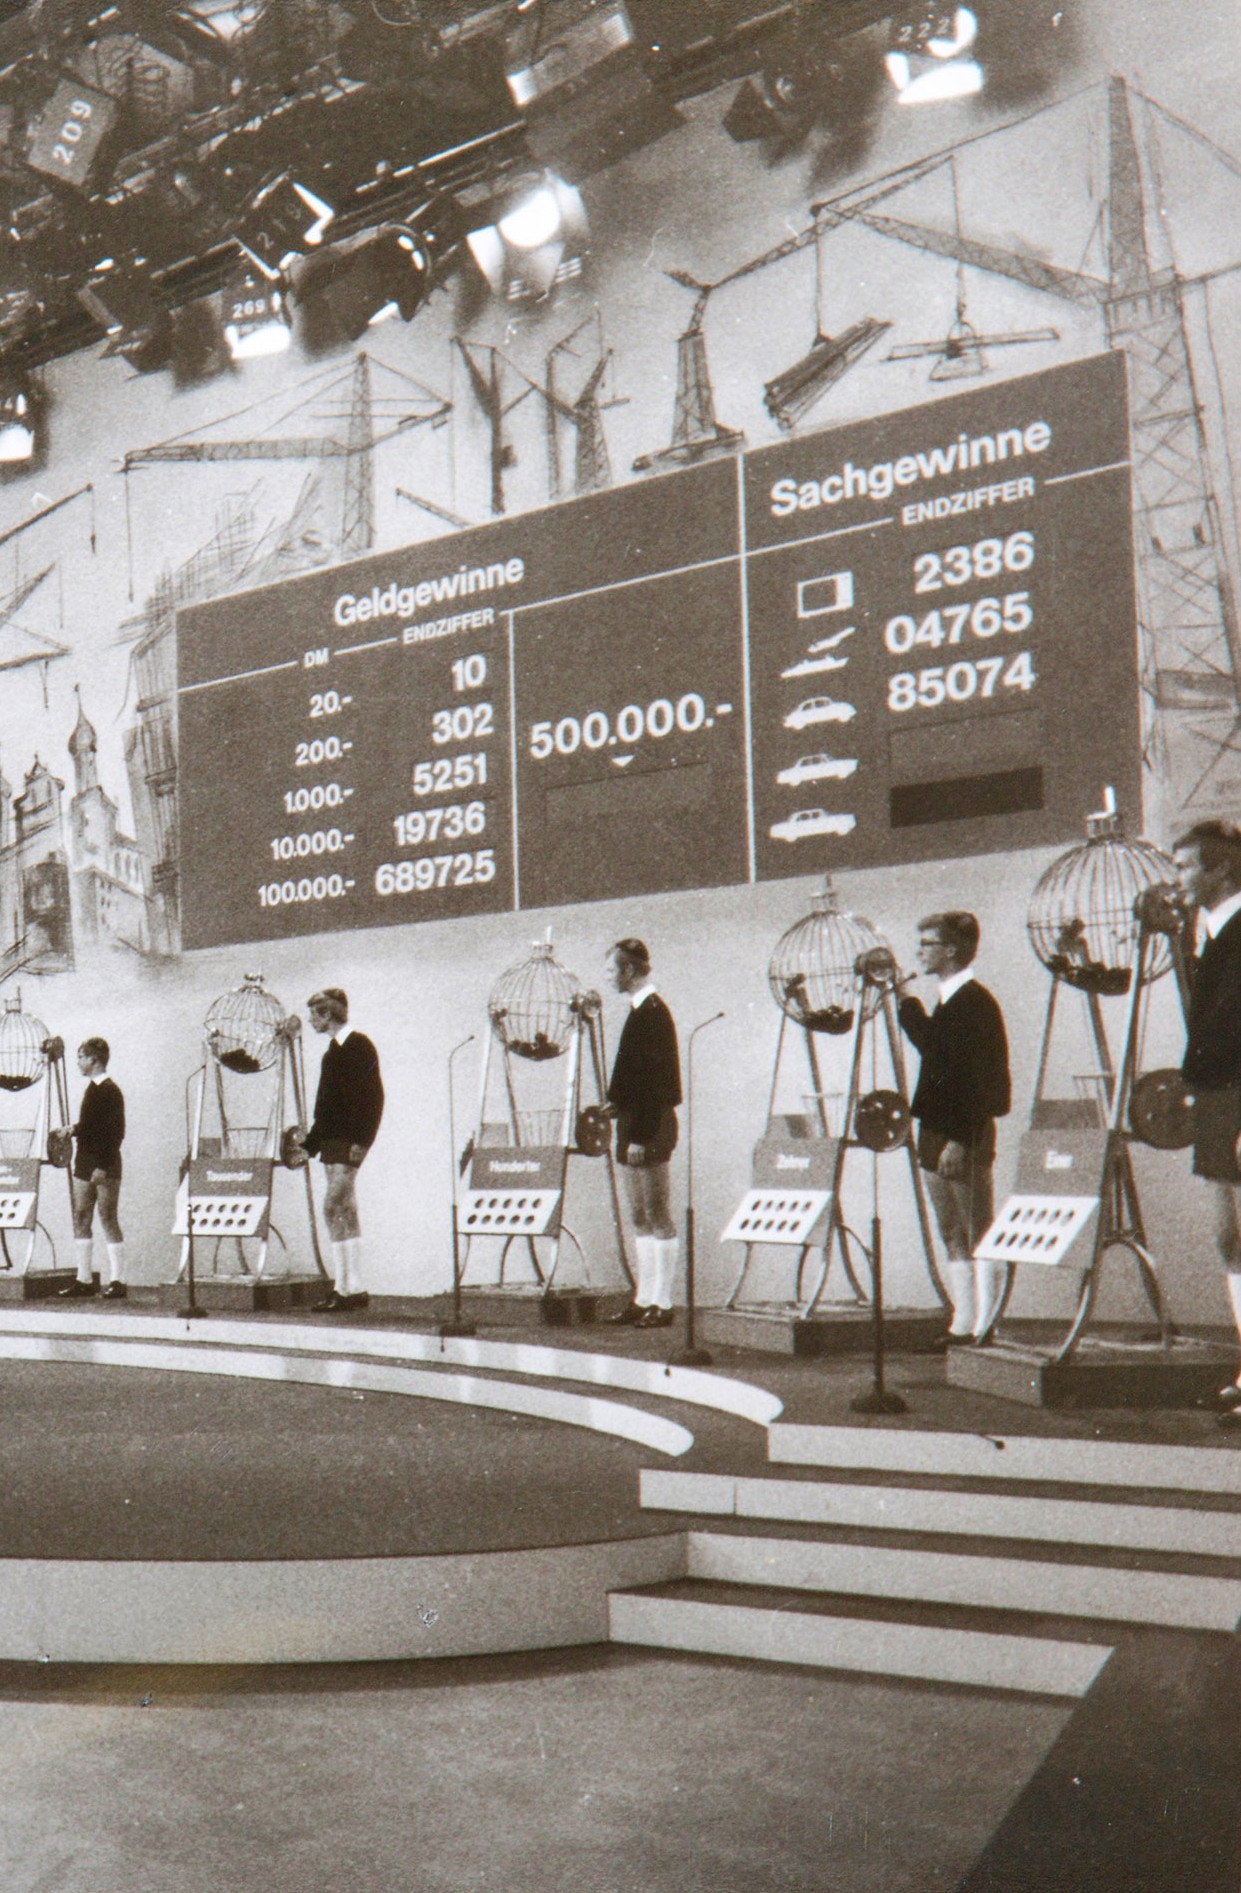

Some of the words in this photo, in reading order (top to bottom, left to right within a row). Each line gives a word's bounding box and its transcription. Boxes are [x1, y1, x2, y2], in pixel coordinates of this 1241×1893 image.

[899, 16, 951, 42] 222
[53, 99, 92, 165] 209
[231, 298, 266, 319] 269
[770, 421, 1052, 517] Sachgewinne
[902, 476, 1035, 526] ENDZIFFER
[913, 531, 1034, 594] 2386
[333, 558, 524, 627] Geldgewinne
[402, 608, 494, 645] ENDZIFFER
[884, 591, 1033, 654] 04765
[303, 647, 329, 669] DM
[451, 654, 487, 691] 10
[309, 690, 353, 718] 20.-
[887, 652, 1036, 712] 85074
[432, 702, 494, 744] 302
[529, 693, 732, 759] 500.000.-
[295, 736, 353, 767] 200.-
[413, 752, 487, 796] 5251
[393, 801, 486, 846] 19736
[375, 849, 496, 896] 689725
